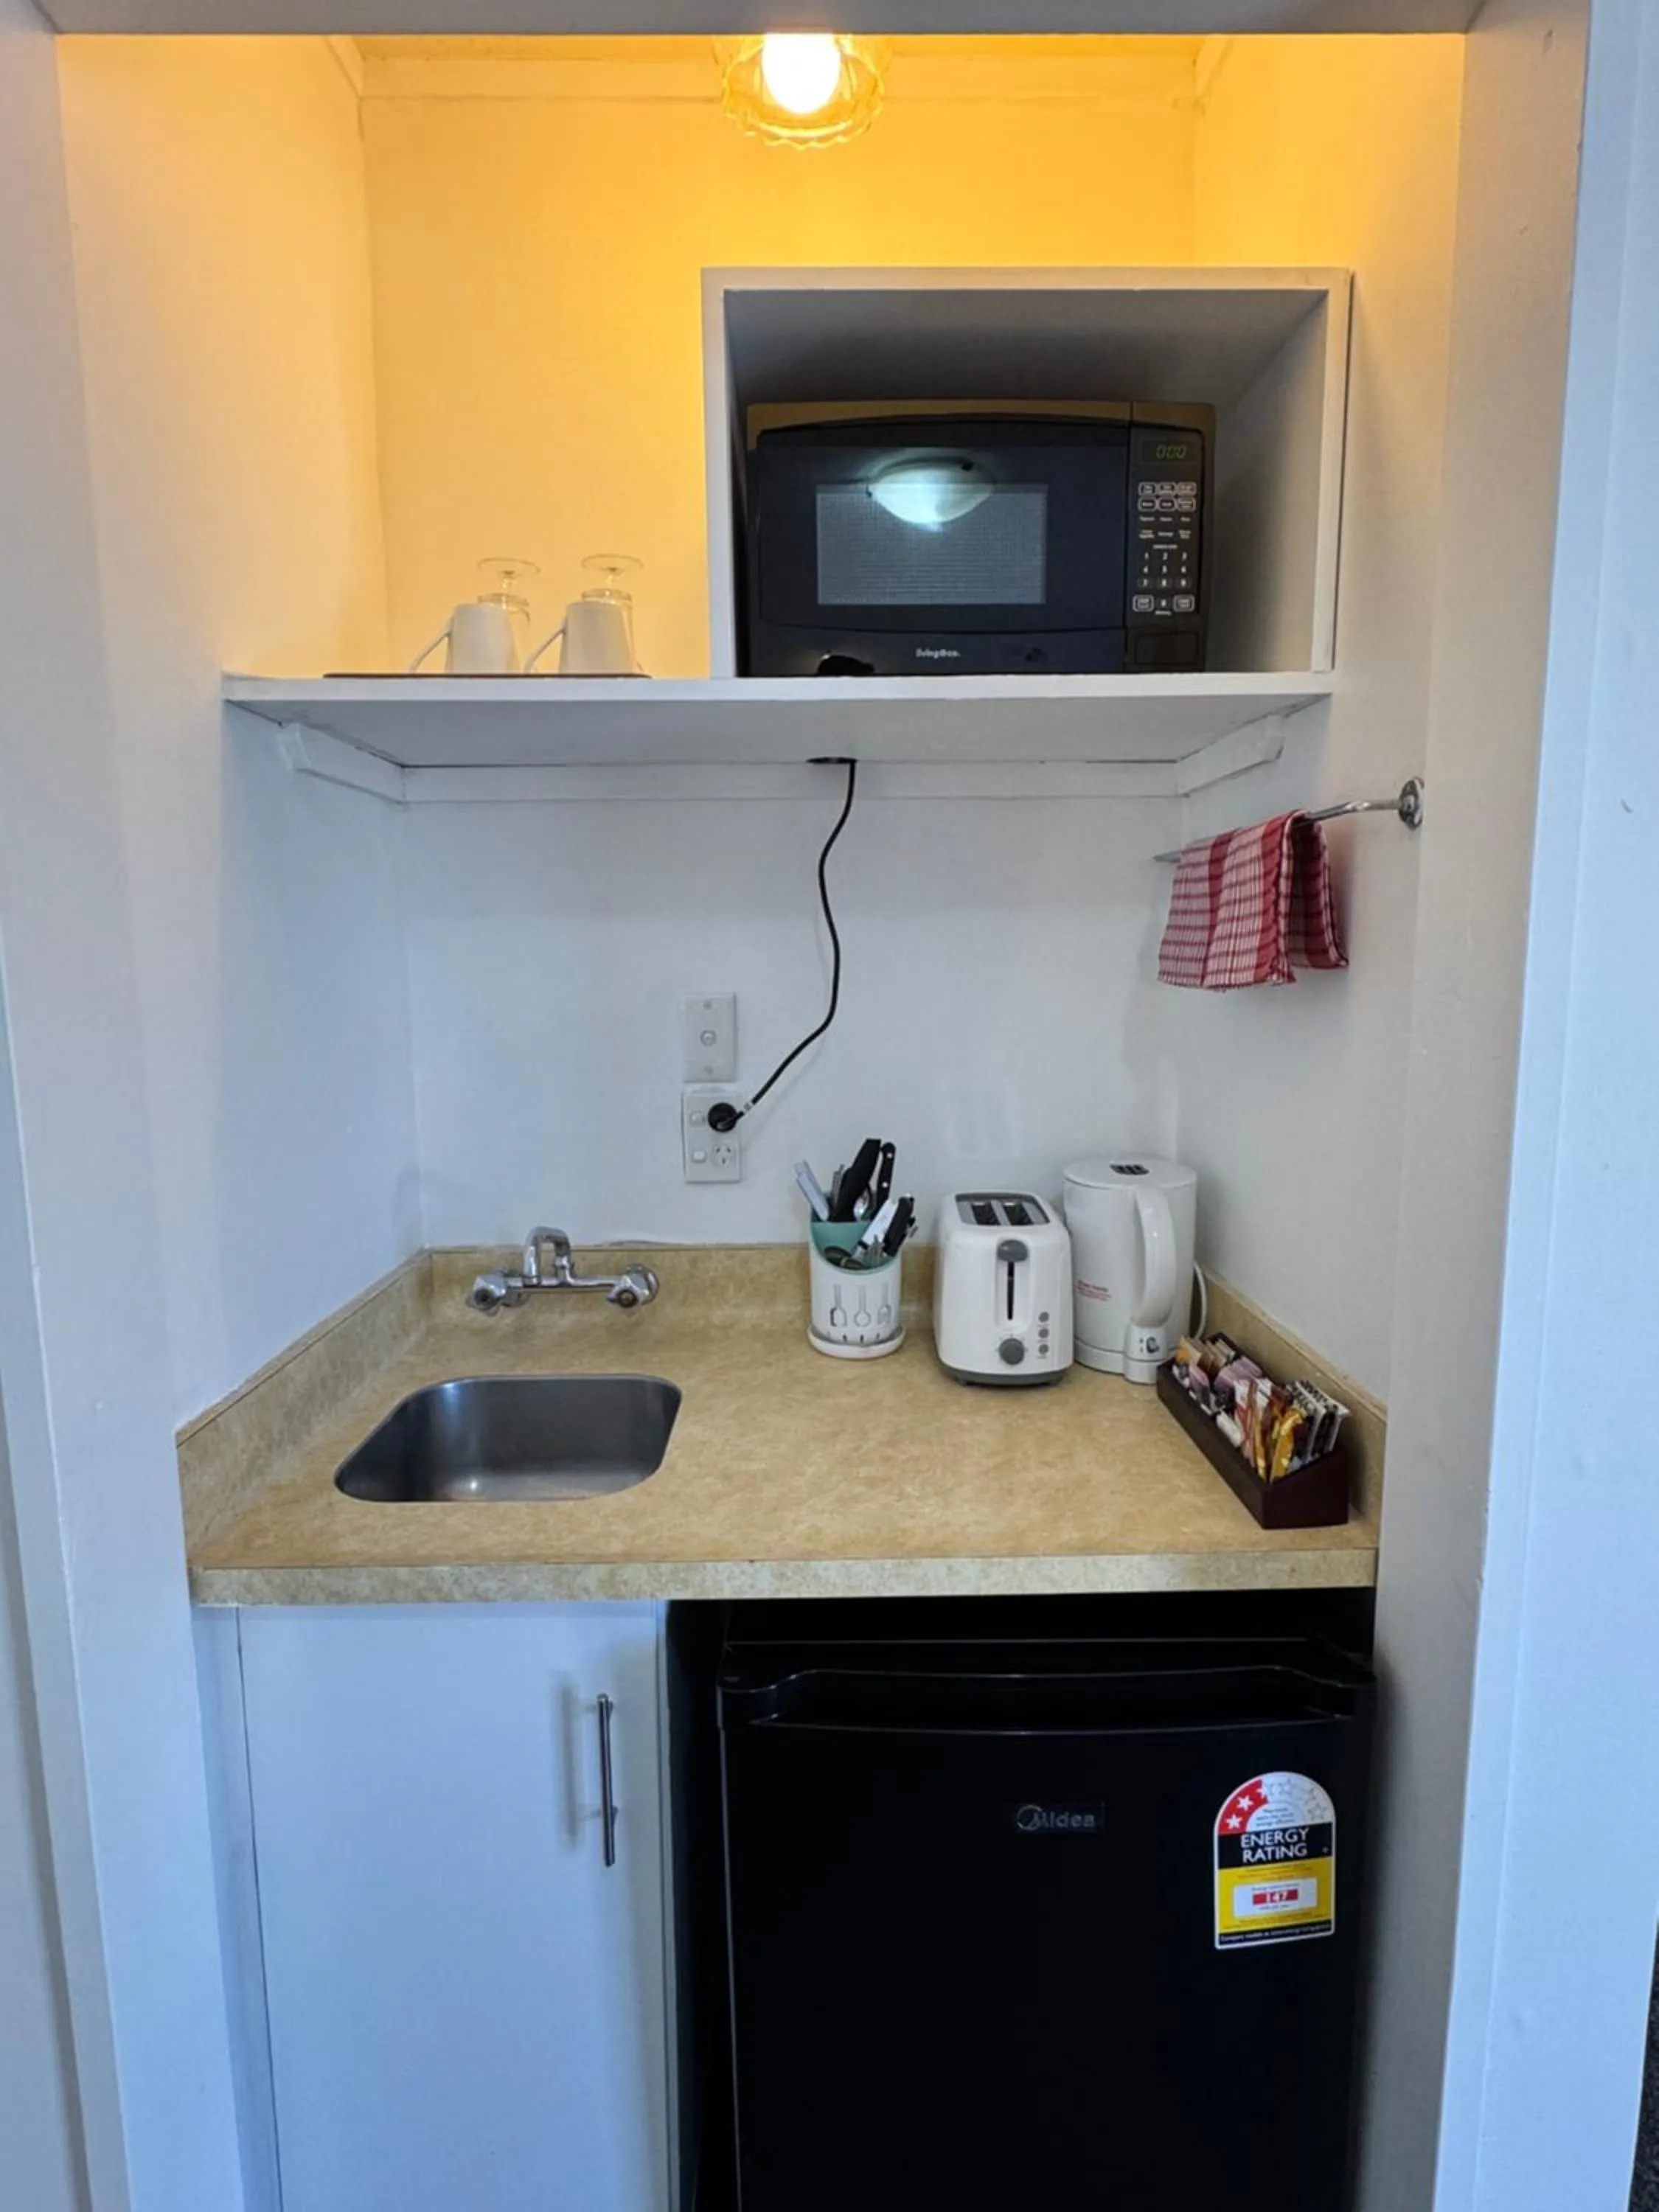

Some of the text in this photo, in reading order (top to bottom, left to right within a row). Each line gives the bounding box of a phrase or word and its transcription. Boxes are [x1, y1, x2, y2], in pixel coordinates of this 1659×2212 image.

[1018, 1806, 1095, 1829] Midea
[1241, 1827, 1310, 1848] ENERGY
[1242, 1843, 1308, 1863] RATING
